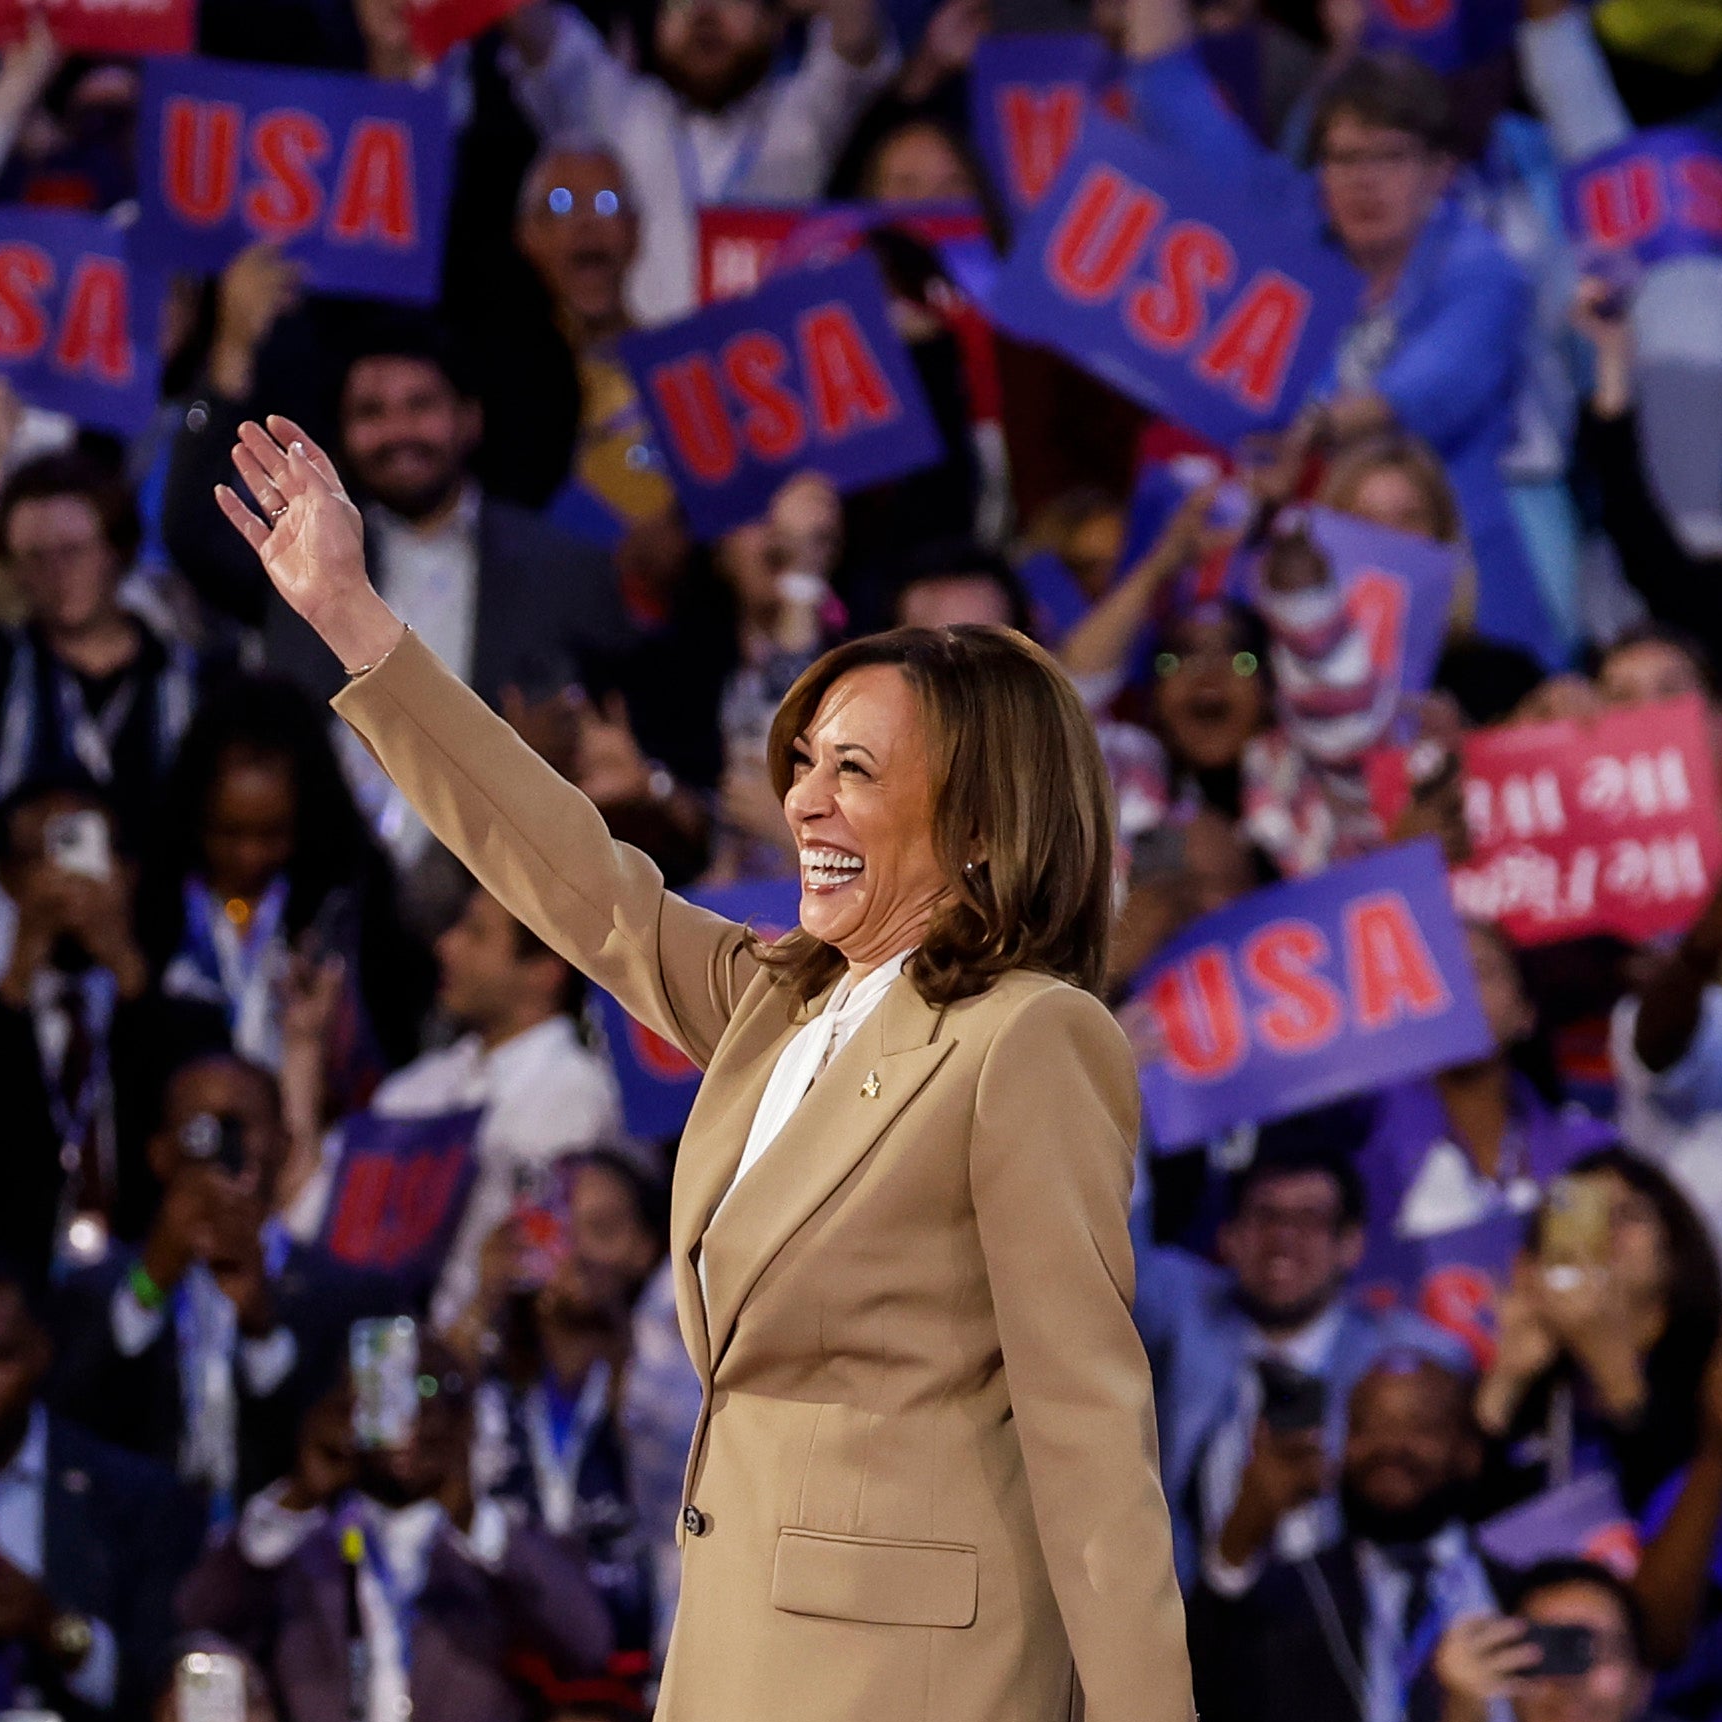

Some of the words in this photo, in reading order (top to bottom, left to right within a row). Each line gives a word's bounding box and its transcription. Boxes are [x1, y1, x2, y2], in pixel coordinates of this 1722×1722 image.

[161, 97, 418, 249] USA
[1047, 163, 1312, 410] USA
[650, 302, 900, 483] USA
[1150, 889, 1452, 1081] USA
